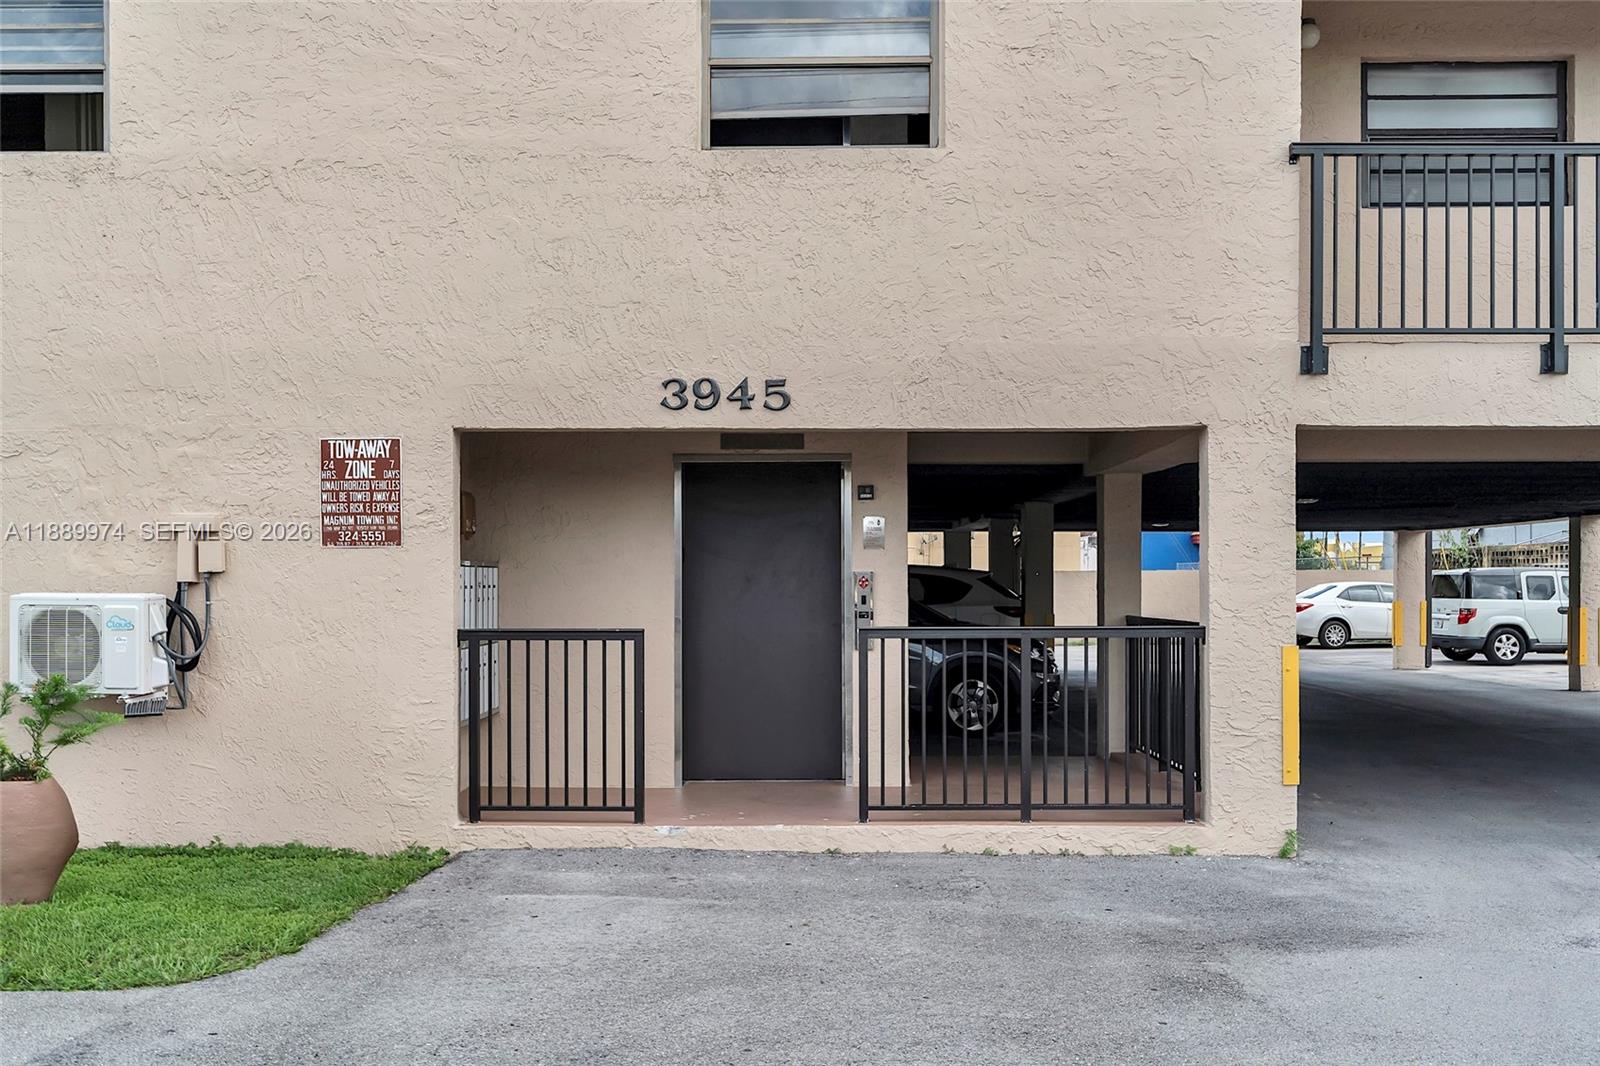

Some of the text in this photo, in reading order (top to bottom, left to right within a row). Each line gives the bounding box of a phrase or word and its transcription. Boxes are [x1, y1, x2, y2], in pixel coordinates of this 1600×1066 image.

[660, 376, 791, 411] 3945
[328, 440, 392, 459] TOW-AWAY
[323, 460, 335, 469] 24
[344, 460, 376, 479] ZONE
[389, 460, 395, 469] 7
[383, 470, 400, 479] DAYS
[321, 480, 400, 490] UNAUTHORIZED VEHICLES
[322, 491, 399, 502] WILL BE TOWED AWAY AT
[321, 503, 400, 514] OWNERS RISK & EXPENSE
[323, 515, 355, 525] MAGNUM
[356, 515, 385, 525] TOWING
